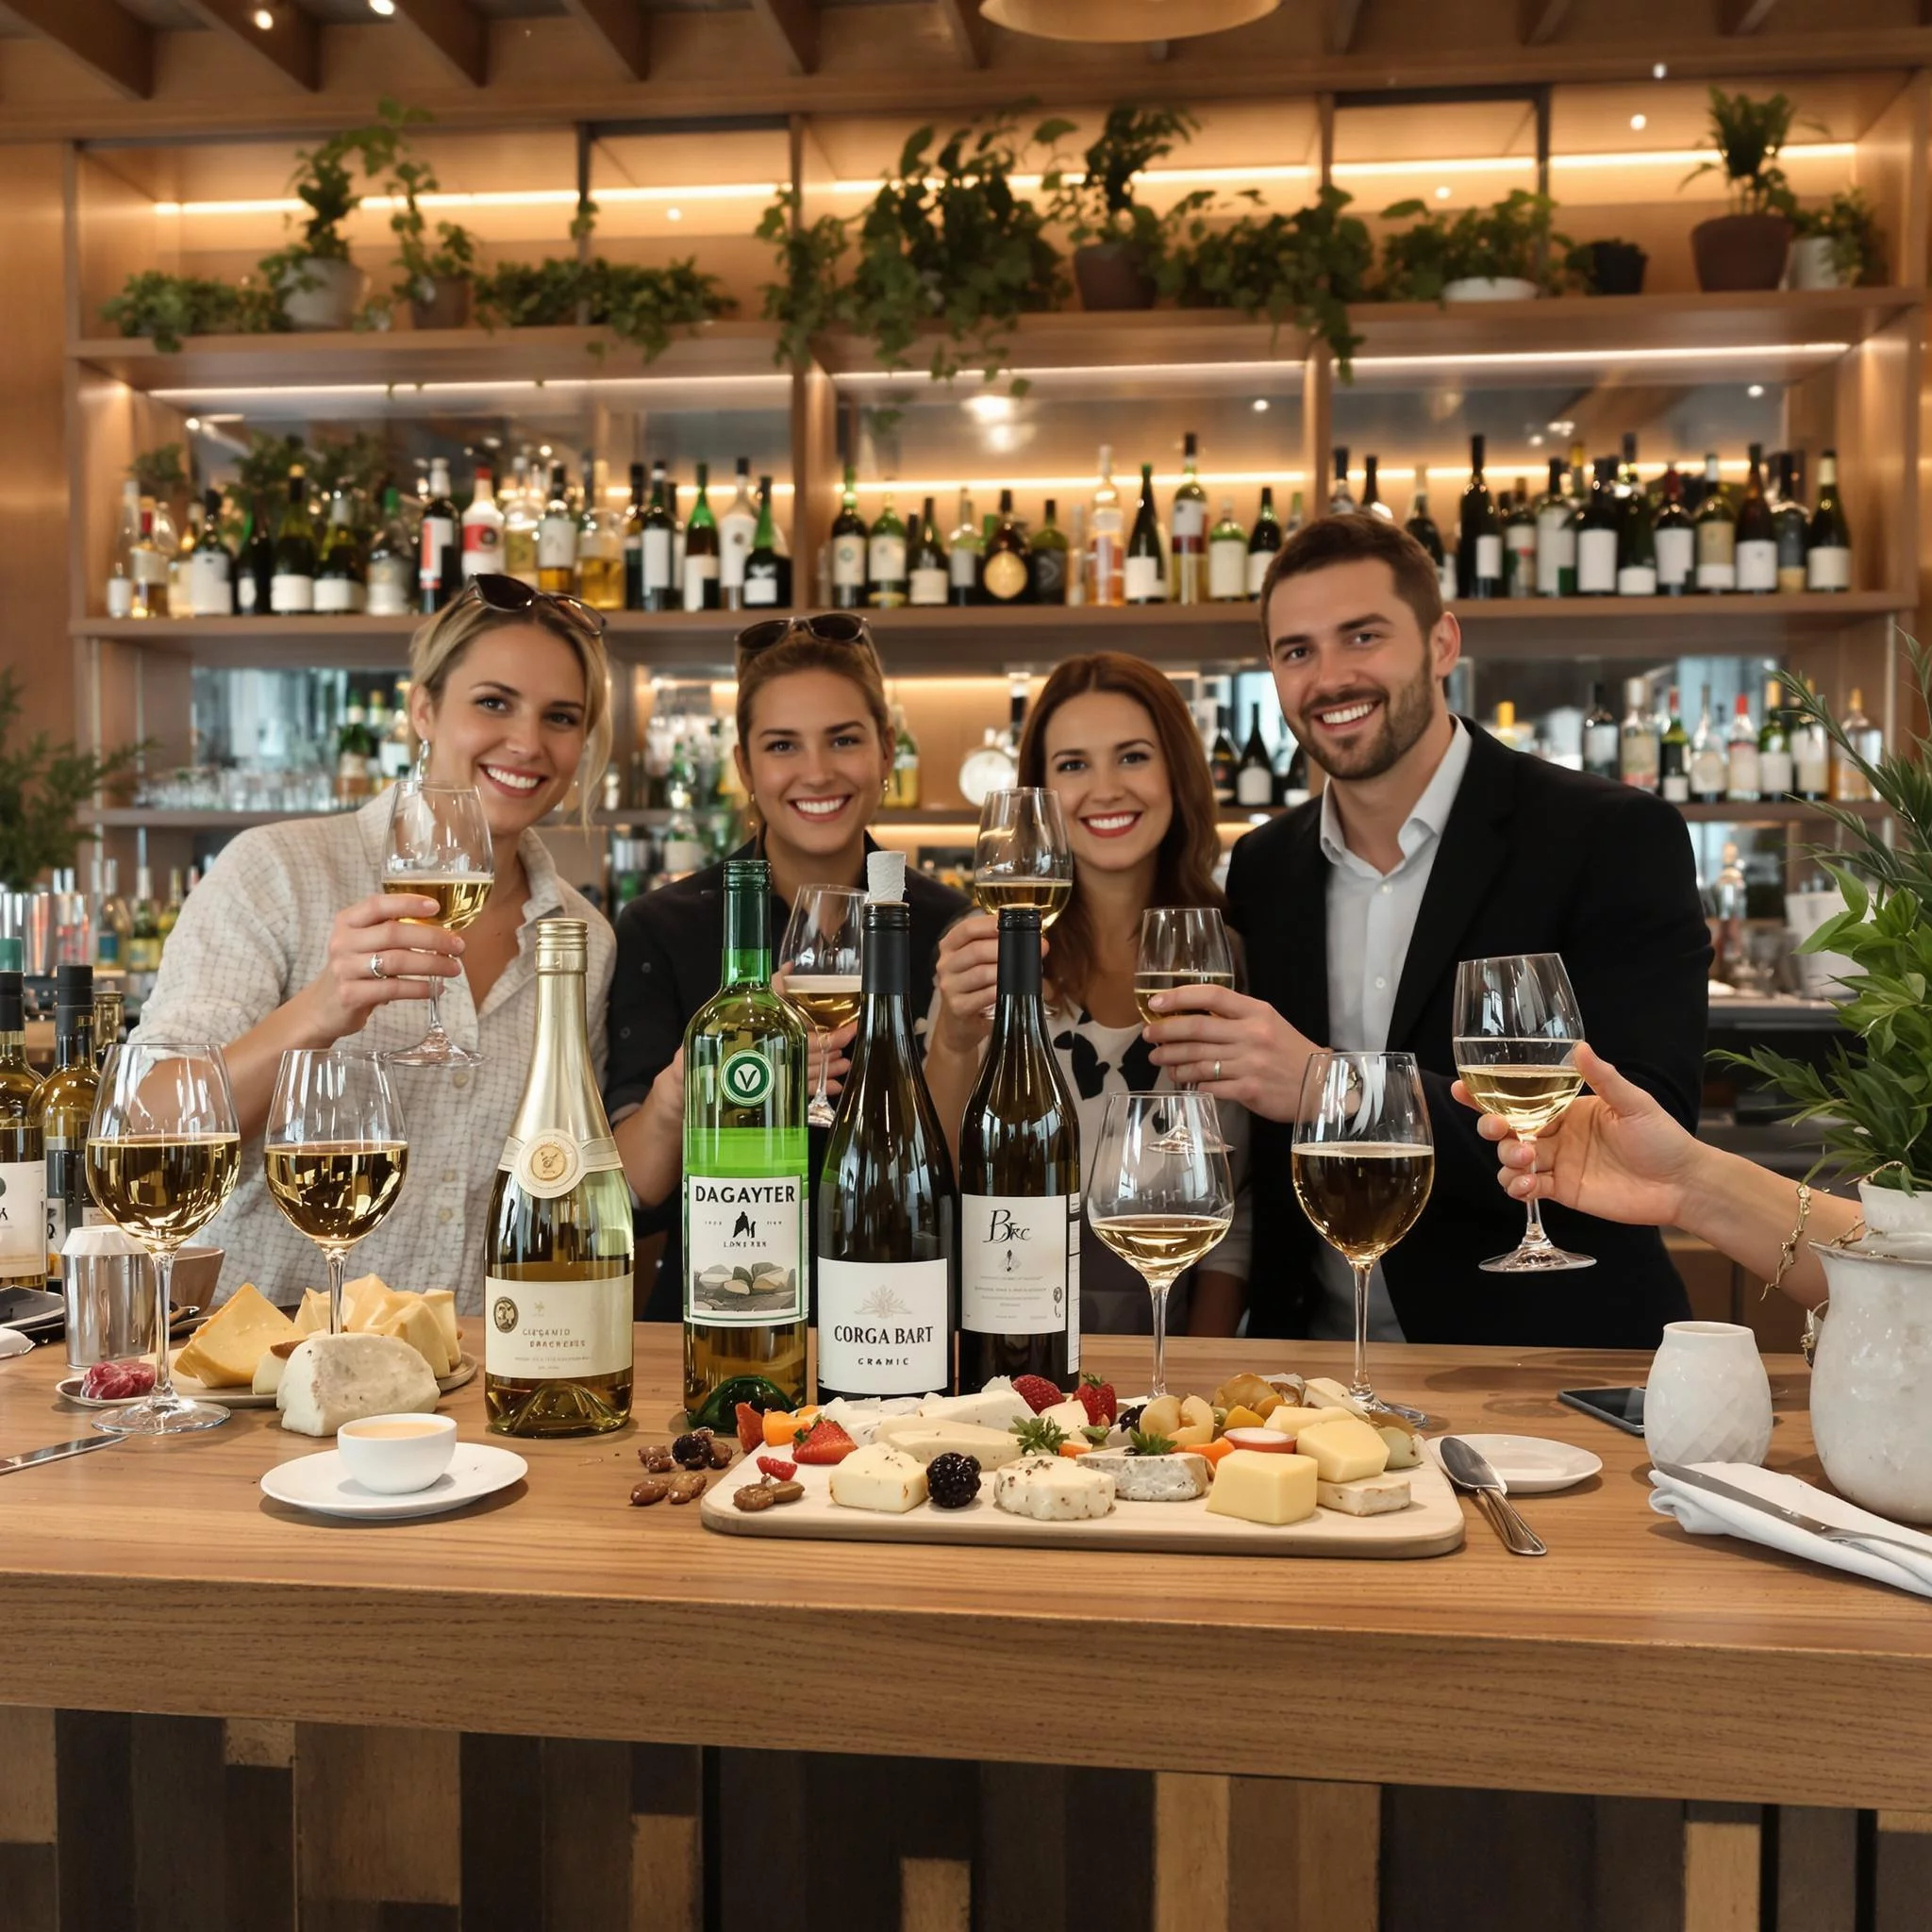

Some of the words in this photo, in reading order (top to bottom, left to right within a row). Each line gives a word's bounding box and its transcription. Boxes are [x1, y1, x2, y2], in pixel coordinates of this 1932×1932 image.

[738, 1069, 758, 1091] V
[695, 1185, 795, 1204] DAGAYTER
[834, 1324, 891, 1344] CORGA
[895, 1325, 934, 1344] BART
